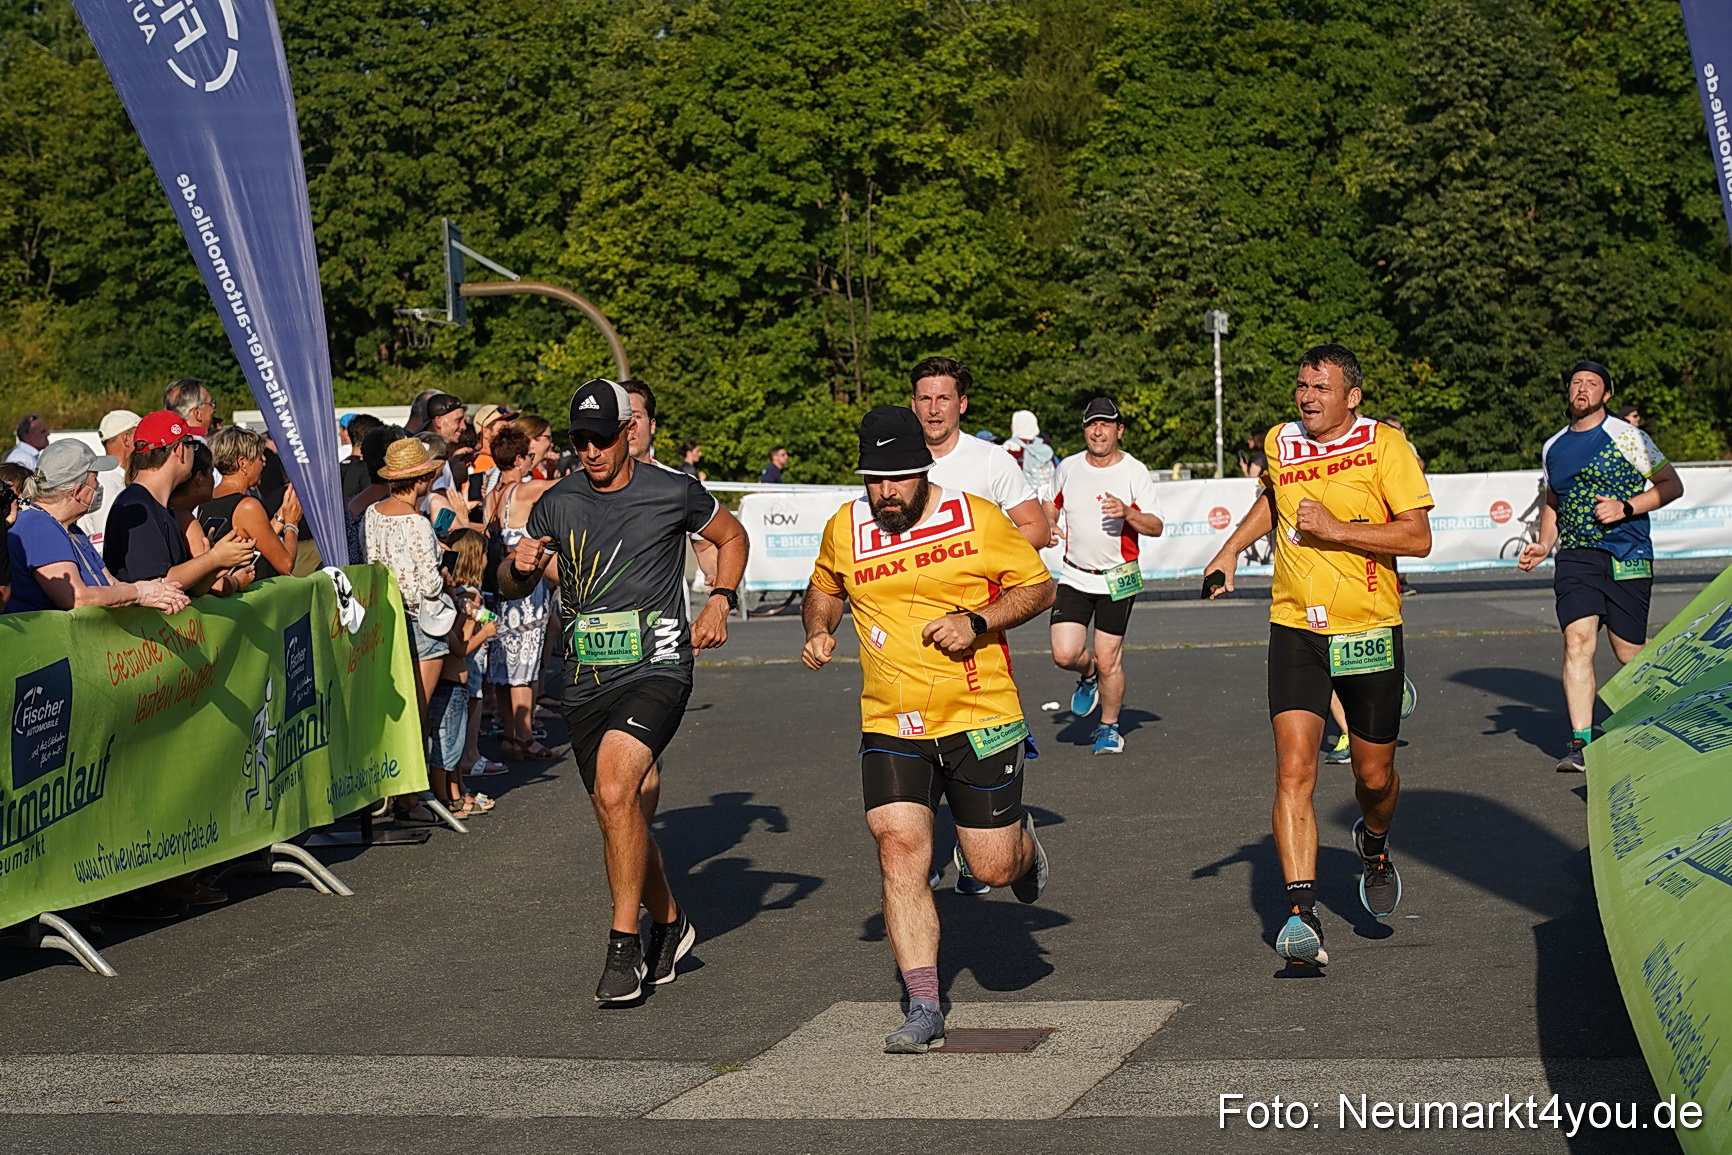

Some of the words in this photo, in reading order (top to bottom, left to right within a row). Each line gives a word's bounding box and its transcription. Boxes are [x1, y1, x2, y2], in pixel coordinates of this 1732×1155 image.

[1279, 466, 1320, 487] MAX
[1327, 451, 1377, 475] BÖGL
[763, 512, 799, 526] NOW
[1430, 515, 1492, 531] HRRÄDER
[1166, 522, 1210, 536] RÄDER
[767, 535, 819, 548] E-BIKES
[854, 558, 908, 586] MAX
[915, 540, 979, 568] BÖGL
[1117, 572, 1137, 588] 928
[577, 637, 587, 655] RUN
[584, 630, 629, 649] 1077
[630, 631, 640, 656] 2022
[1341, 637, 1386, 659] 1586
[107, 627, 163, 687] Gesunde
[158, 618, 206, 659] Firmen
[585, 648, 607, 656] Wagner
[607, 648, 632, 656] Mathias
[1333, 648, 1341, 667] RUN
[1340, 658, 1363, 667] Schmid
[22, 698, 65, 728] Fischer
[26, 717, 60, 738] AUTOMOBILE
[982, 735, 1001, 747] Rosca
[0, 734, 116, 847] irmenlauf
[0, 834, 45, 878] eumarkt
[73, 812, 219, 884] www.firmenlauf-oberpfalz.de
